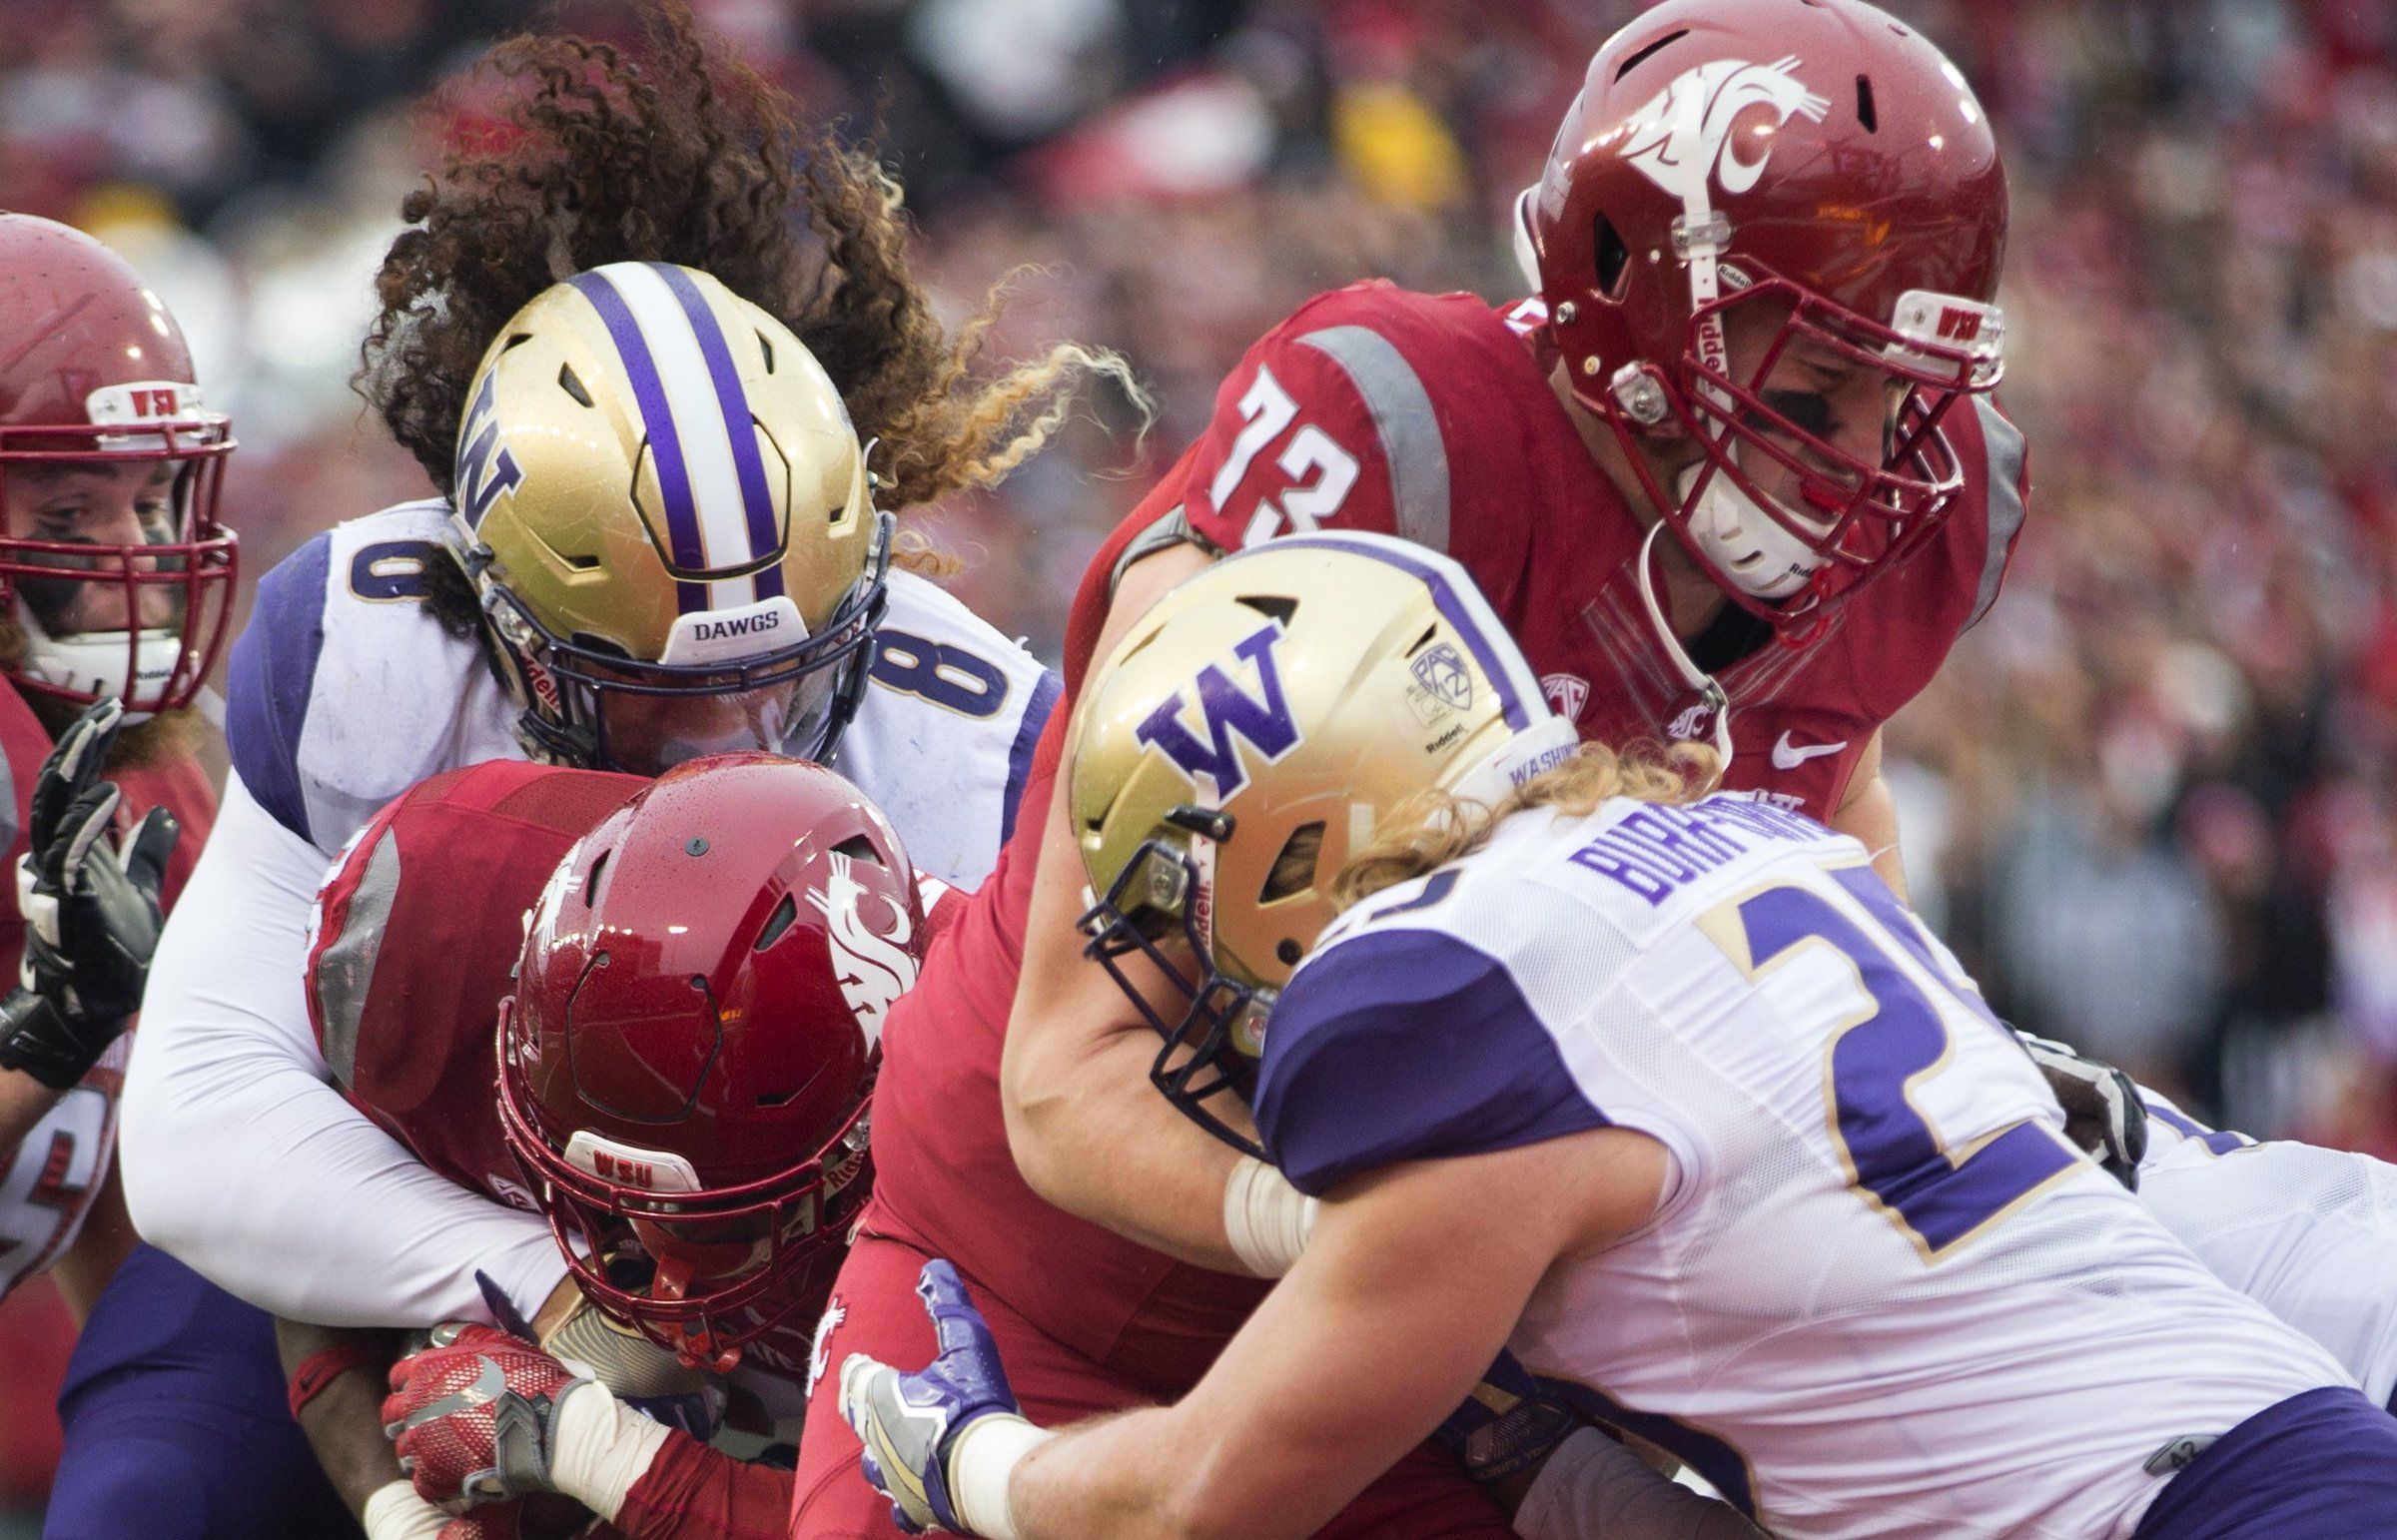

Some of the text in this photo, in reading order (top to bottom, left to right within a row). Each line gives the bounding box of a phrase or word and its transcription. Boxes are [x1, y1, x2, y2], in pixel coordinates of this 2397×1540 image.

[1209, 362, 1361, 548] 73
[694, 610, 779, 641] DAWGS
[867, 629, 1013, 721] 8
[1132, 616, 1306, 810] W
[592, 1150, 653, 1188] WSU
